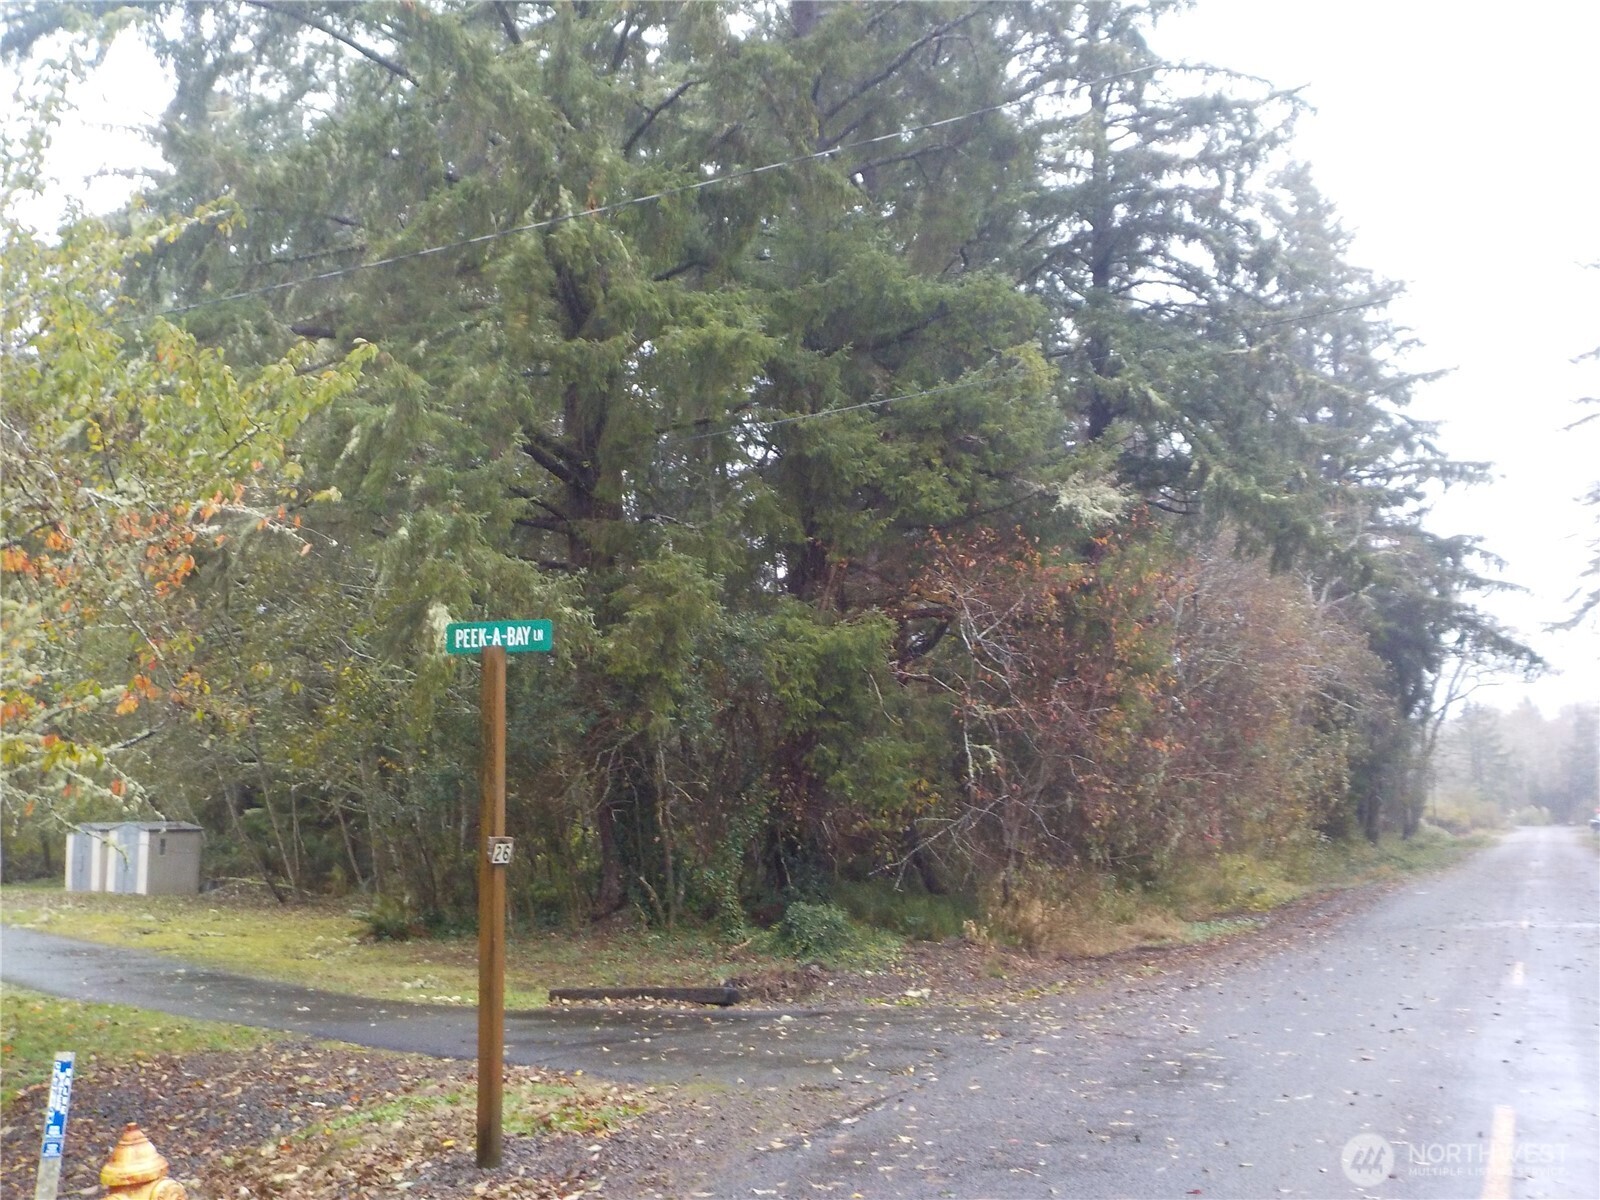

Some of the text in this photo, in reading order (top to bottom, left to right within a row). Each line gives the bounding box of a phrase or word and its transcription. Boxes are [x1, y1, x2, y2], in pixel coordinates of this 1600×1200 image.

[455, 626, 544, 648] PEEK-A-BAY LN
[494, 845, 510, 862] 26
